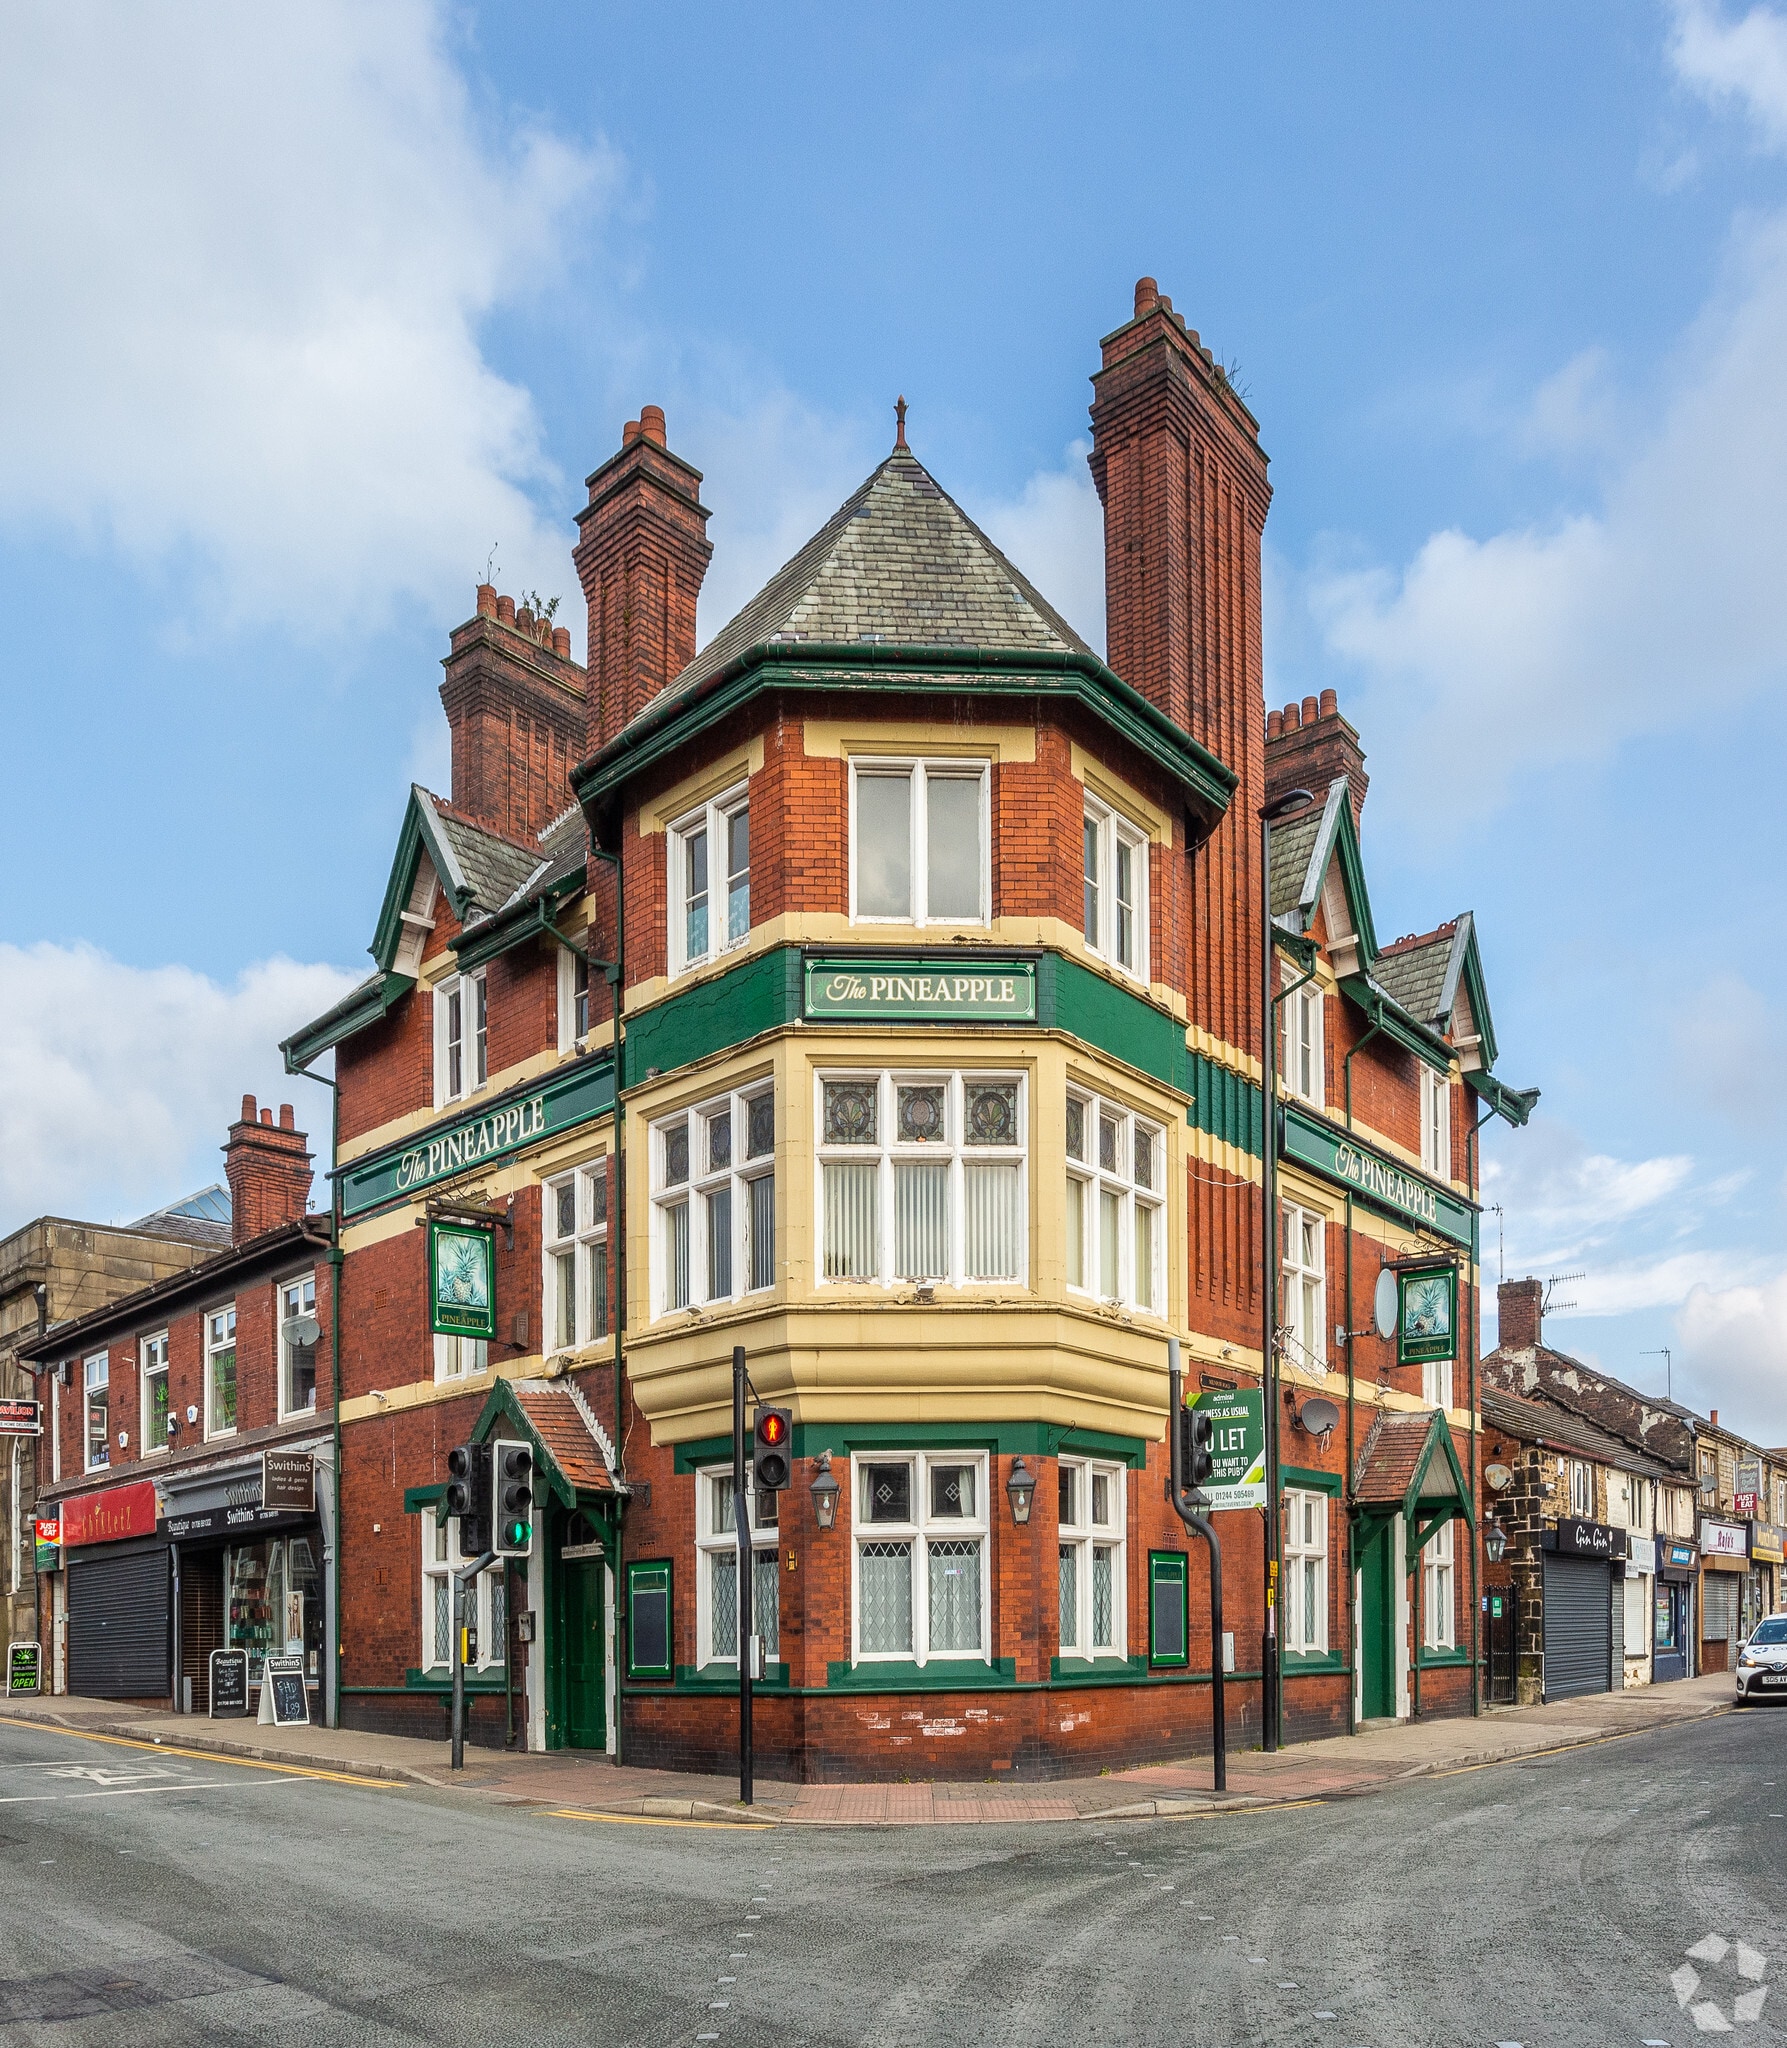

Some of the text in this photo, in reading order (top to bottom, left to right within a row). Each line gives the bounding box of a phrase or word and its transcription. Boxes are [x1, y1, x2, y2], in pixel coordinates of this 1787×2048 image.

[825, 975, 1016, 1002] The PINEAPPLE
[396, 1096, 546, 1189] The PINEAPPLE
[1334, 1143, 1437, 1222] The PINEAPPLE
[441, 1313, 487, 1328] PINEAPPLE
[1408, 1344, 1446, 1356] PINEAPPLE
[1212, 1393, 1235, 1402] admiral
[1222, 1407, 1230, 1417] AS
[1230, 1405, 1250, 1416] USUAL
[1219, 1427, 1247, 1451] LET
[1212, 1456, 1249, 1468] OU WANT TO
[1213, 1467, 1244, 1478] THIS PUB?
[1215, 1490, 1232, 1501] 01244
[1736, 1494, 1754, 1502] JUST
[40, 1522, 57, 1530] JUST
[1575, 1525, 1608, 1550] Gin Gin
[12, 1677, 36, 1688] OPEN
